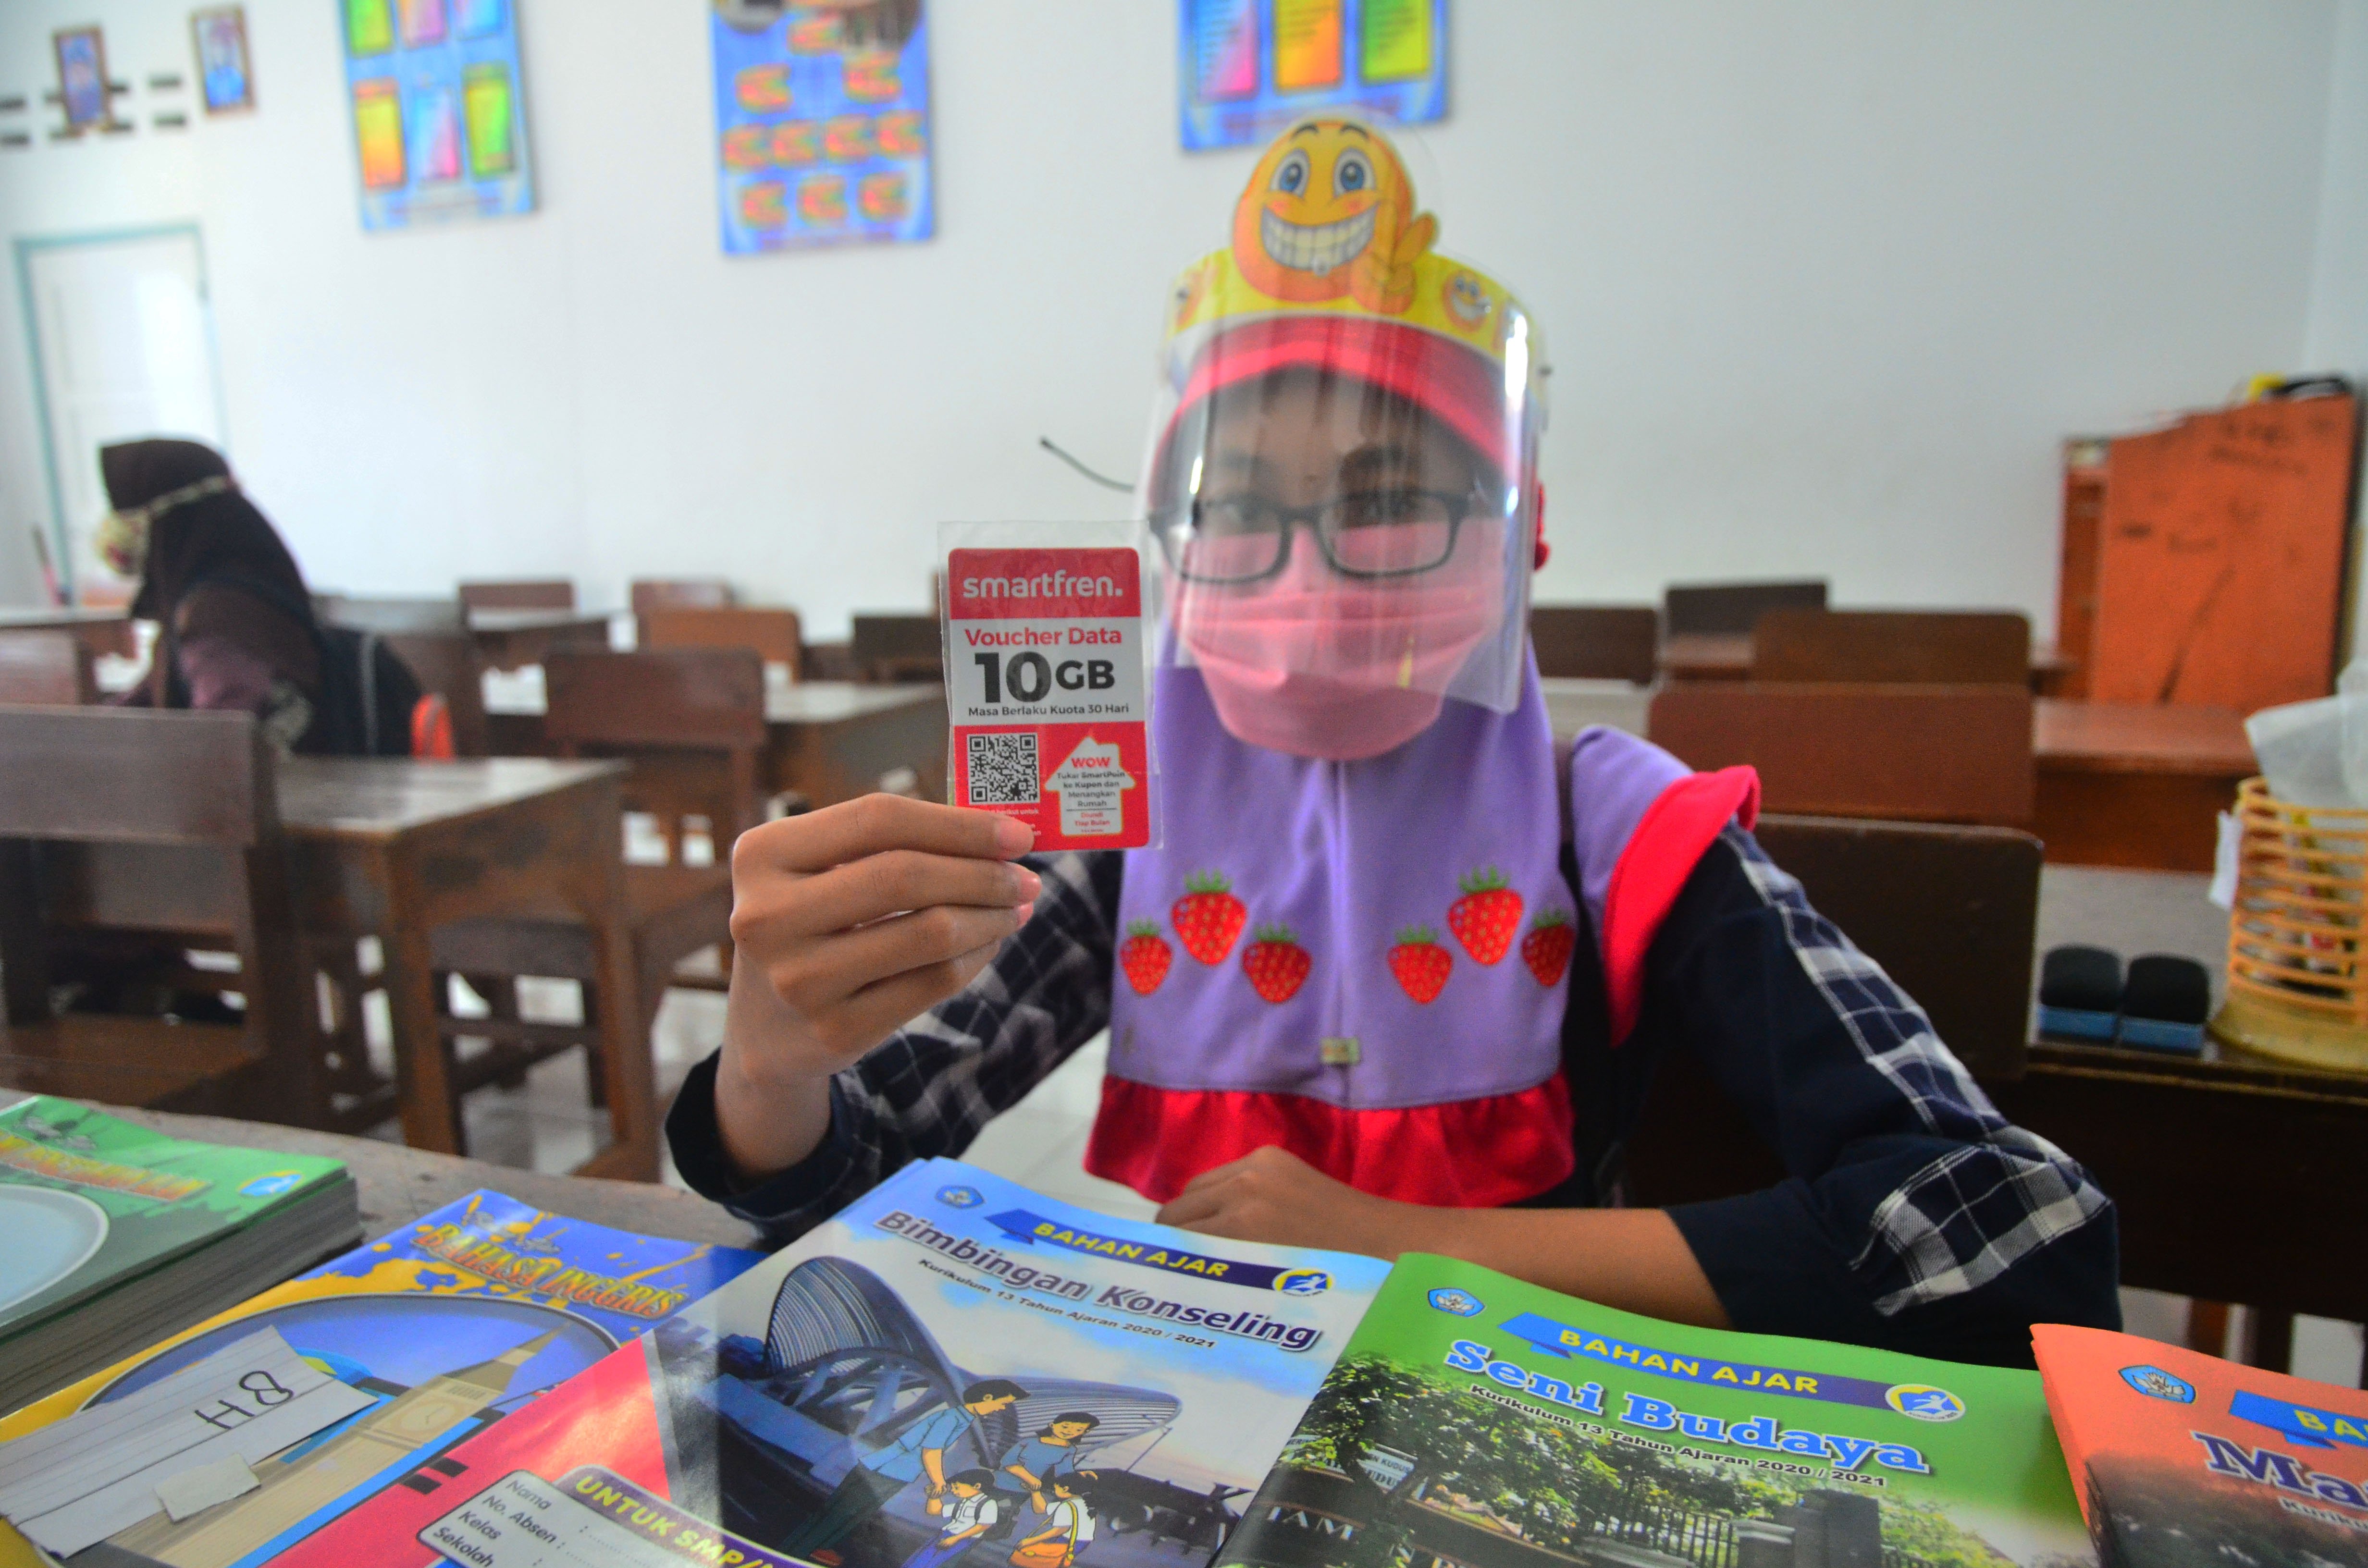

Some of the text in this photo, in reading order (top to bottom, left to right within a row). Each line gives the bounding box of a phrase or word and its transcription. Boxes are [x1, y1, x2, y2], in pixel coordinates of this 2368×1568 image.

[963, 570, 1123, 598] smartfren.
[965, 627, 1122, 646] Voucher Data
[969, 703, 1129, 716] Masa Berlaku Kuota 30 Hari
[1072, 757, 1111, 768] WOW
[1068, 790, 1116, 798] Menangkan
[414, 1223, 555, 1286] BAHASA
[1034, 1222, 1230, 1277] BAHAN AJAR
[876, 1210, 1320, 1350] Bimbingan Konseling
[918, 1259, 992, 1293] Kurikulum
[997, 1290, 1014, 1301] 13
[1019, 1298, 1064, 1315] Tahun
[1067, 1311, 1118, 1328] Ajaran
[1122, 1323, 1162, 1338] 2020
[1175, 1334, 1216, 1348] 2021
[1559, 1329, 1819, 1394] BAHAN AJAR
[1444, 1339, 1929, 1474] Seni Budaya
[2294, 1409, 2368, 1441] BA
[1470, 1385, 1571, 1426] Kurikulum
[1578, 1422, 1603, 1435] 13
[1610, 1431, 1673, 1453] Tahun
[1680, 1446, 1750, 1467] Ajaran
[1757, 1459, 1811, 1476] 2020
[1832, 1470, 1884, 1487] 2021
[2189, 1429, 2368, 1509] Ma
[482, 1495, 557, 1544] No. Absen
[506, 1480, 551, 1510] Nama
[576, 1476, 677, 1537] UNTUK
[433, 1526, 494, 1568] Sekolah
[458, 1510, 501, 1540] Kelas
